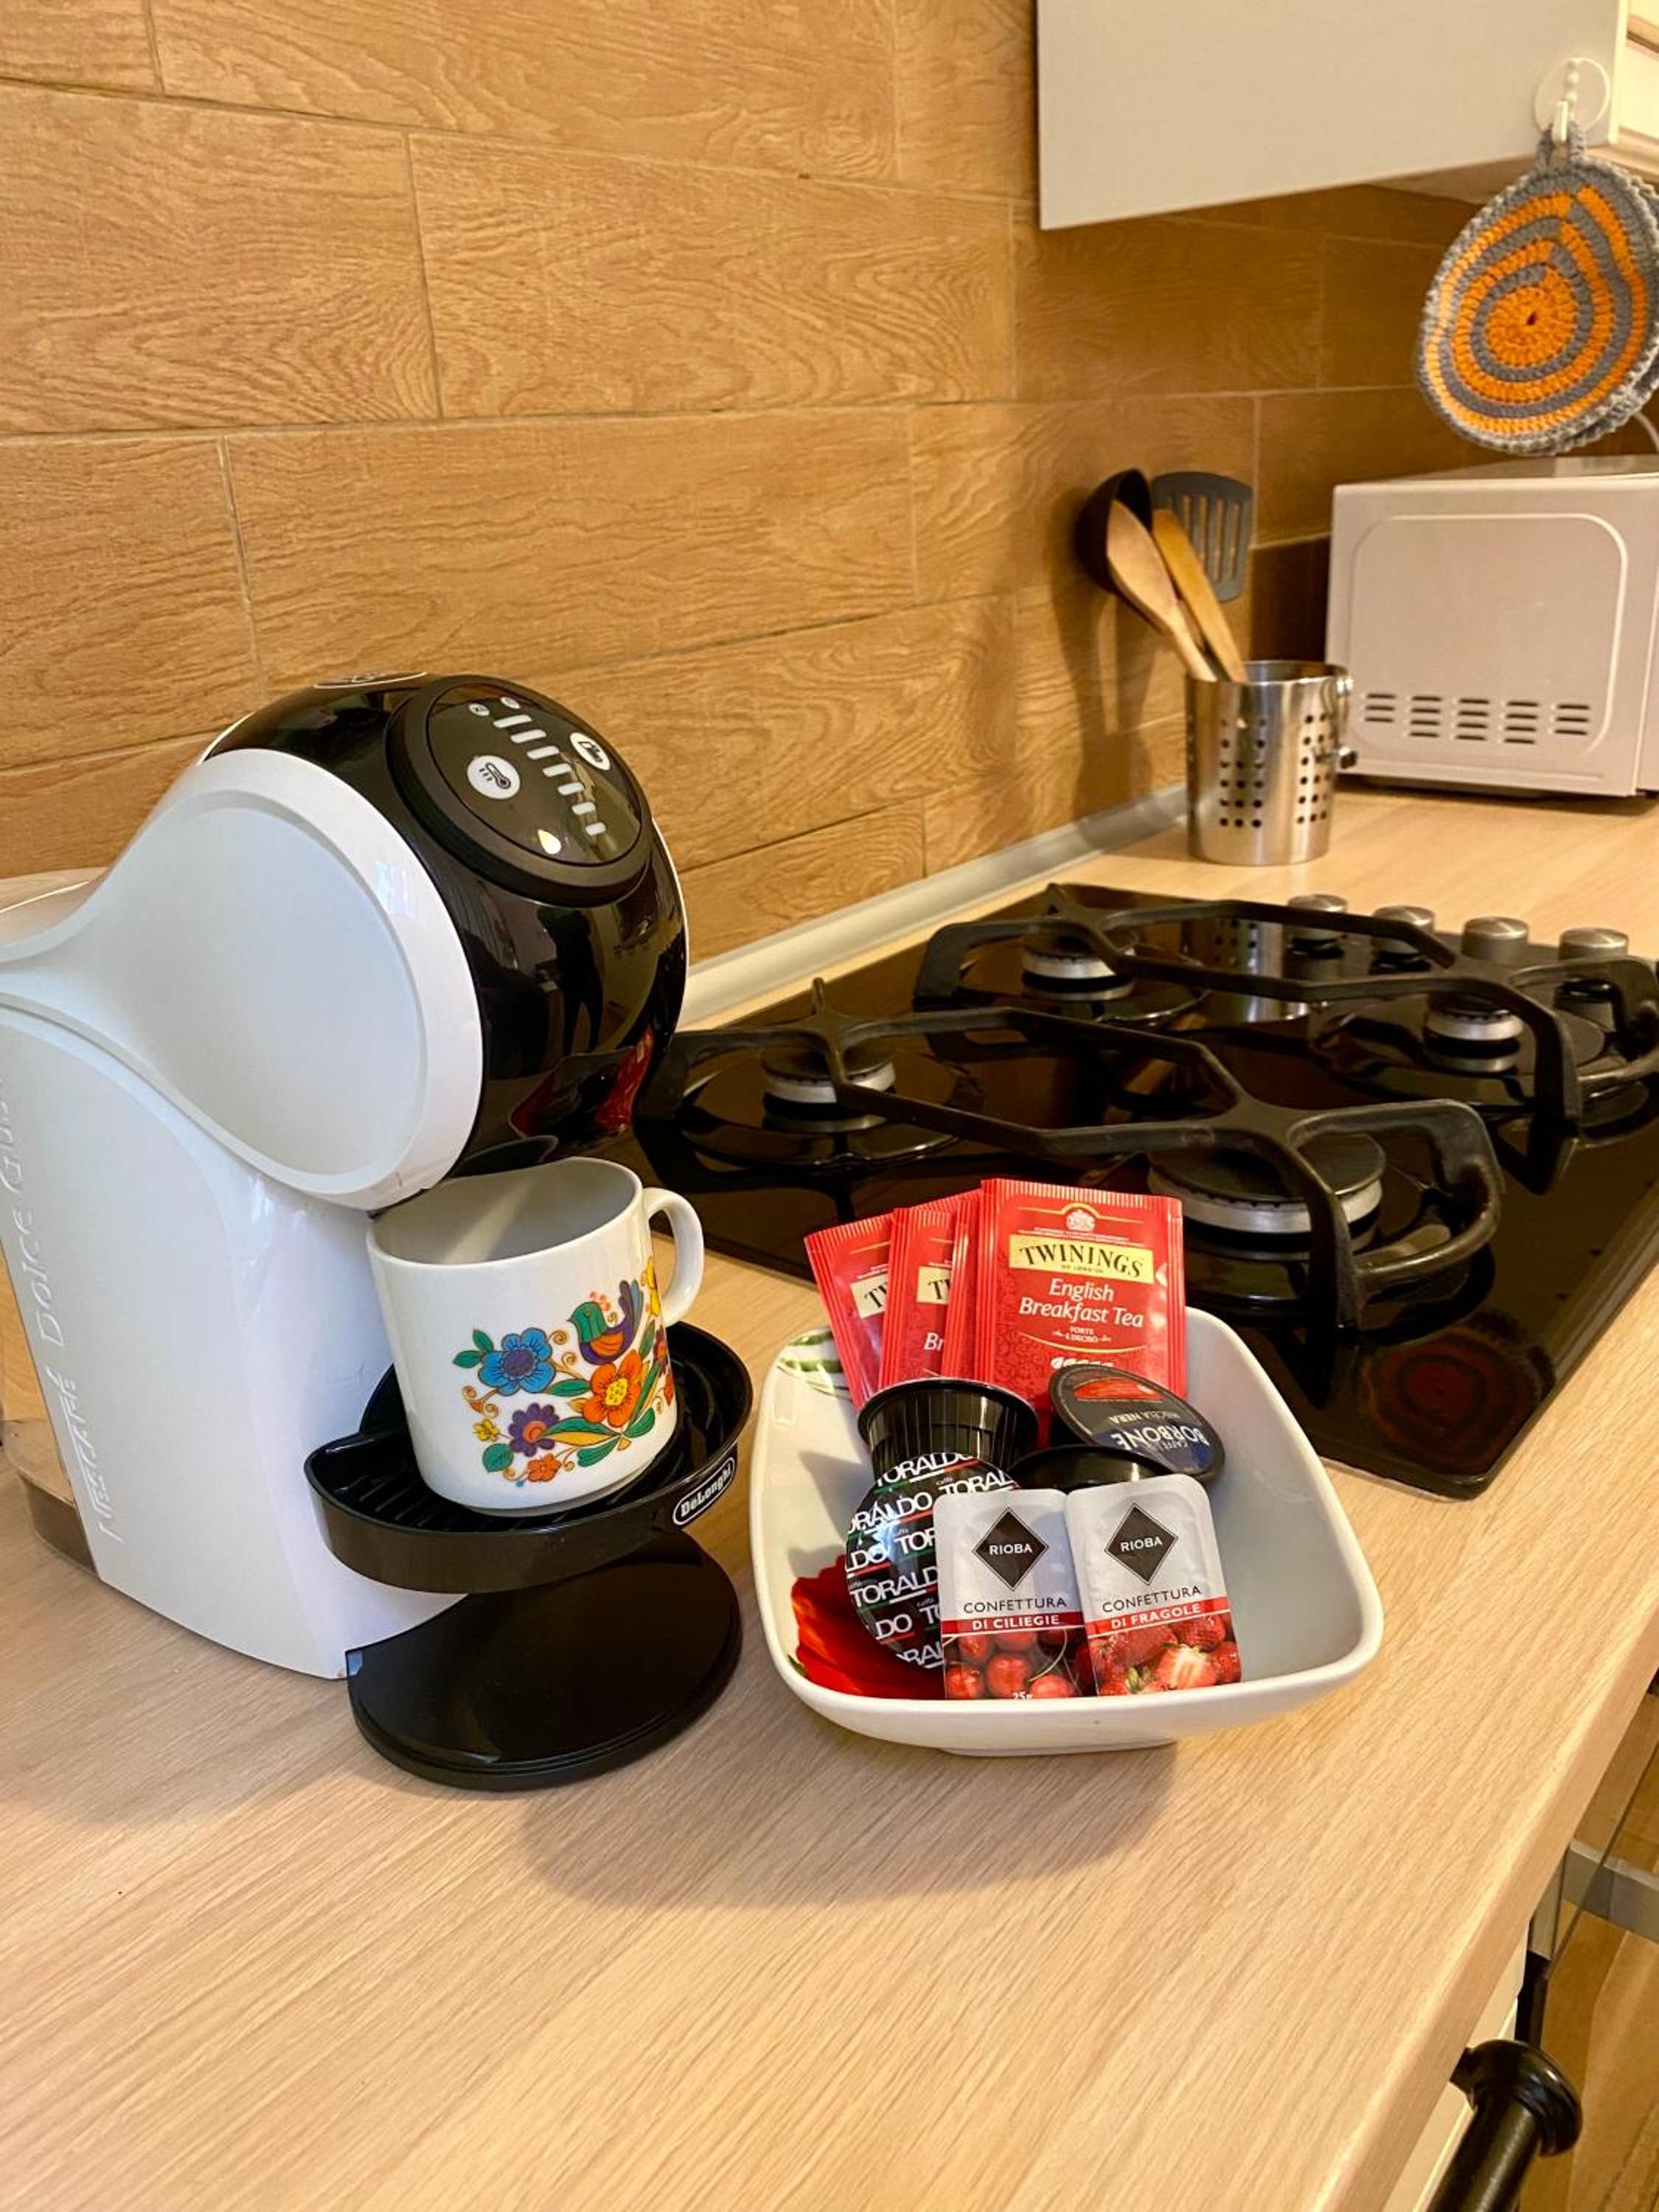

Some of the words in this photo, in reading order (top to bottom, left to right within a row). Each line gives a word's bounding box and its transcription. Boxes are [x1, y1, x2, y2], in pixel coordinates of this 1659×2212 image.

[1019, 1243, 1144, 1278] TWININGS
[1049, 1278, 1114, 1302] English
[1019, 1297, 1108, 1323] Breakfast
[1113, 1307, 1144, 1328] Tea
[1110, 1425, 1210, 1450] BORBONE
[681, 1463, 731, 1517] DeLonghi
[990, 1543, 1033, 1555] RIOBA
[1120, 1536, 1163, 1552] RIOBA
[964, 1597, 1067, 1613] CONFETTURA
[1102, 1585, 1202, 1613] CONFETTURA
[973, 1620, 988, 1630] DI
[993, 1615, 1060, 1628] CILIEGIE
[1111, 1618, 1126, 1630] DI
[1132, 1604, 1201, 1626] FRAGOLE
